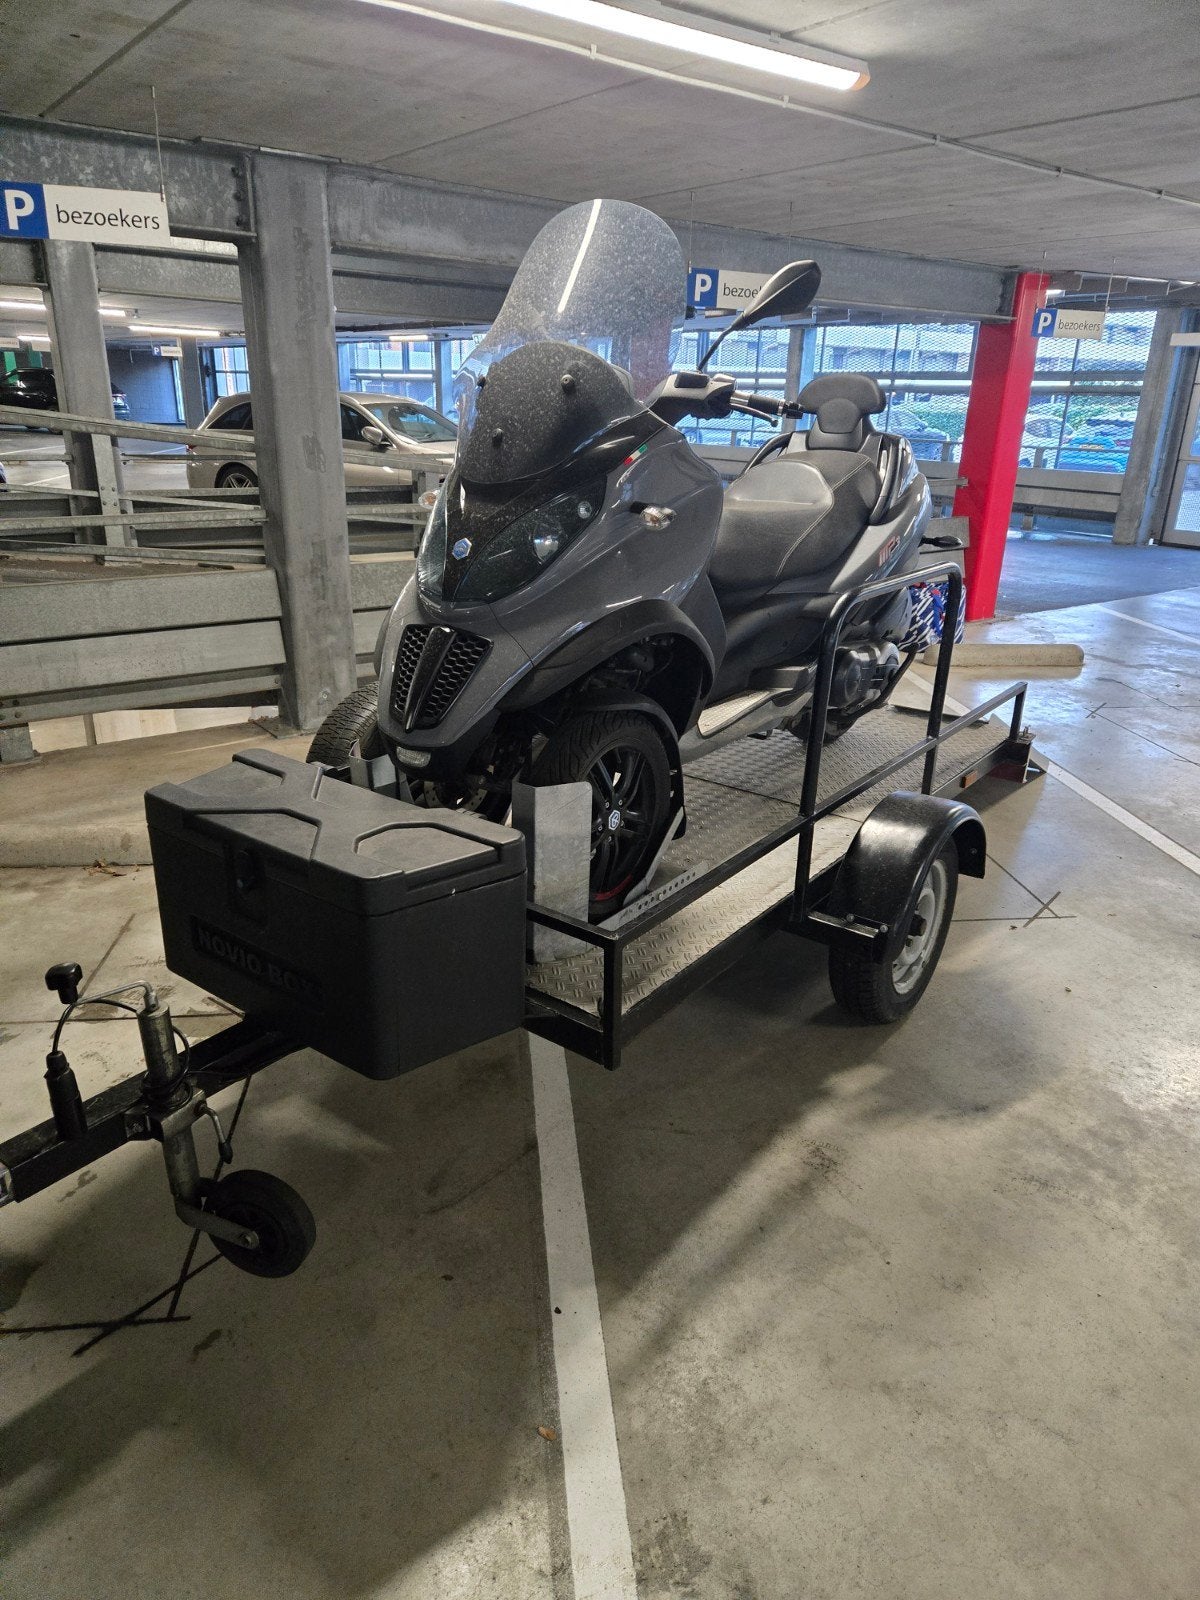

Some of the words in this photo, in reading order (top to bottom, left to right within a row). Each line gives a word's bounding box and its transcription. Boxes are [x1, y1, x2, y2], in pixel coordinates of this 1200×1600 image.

[4, 189, 35, 231] P
[56, 204, 160, 230] bezoekers
[694, 273, 712, 302] P
[722, 283, 763, 299] bezoe
[1037, 312, 1052, 334] P
[1058, 320, 1101, 332] bezoekers
